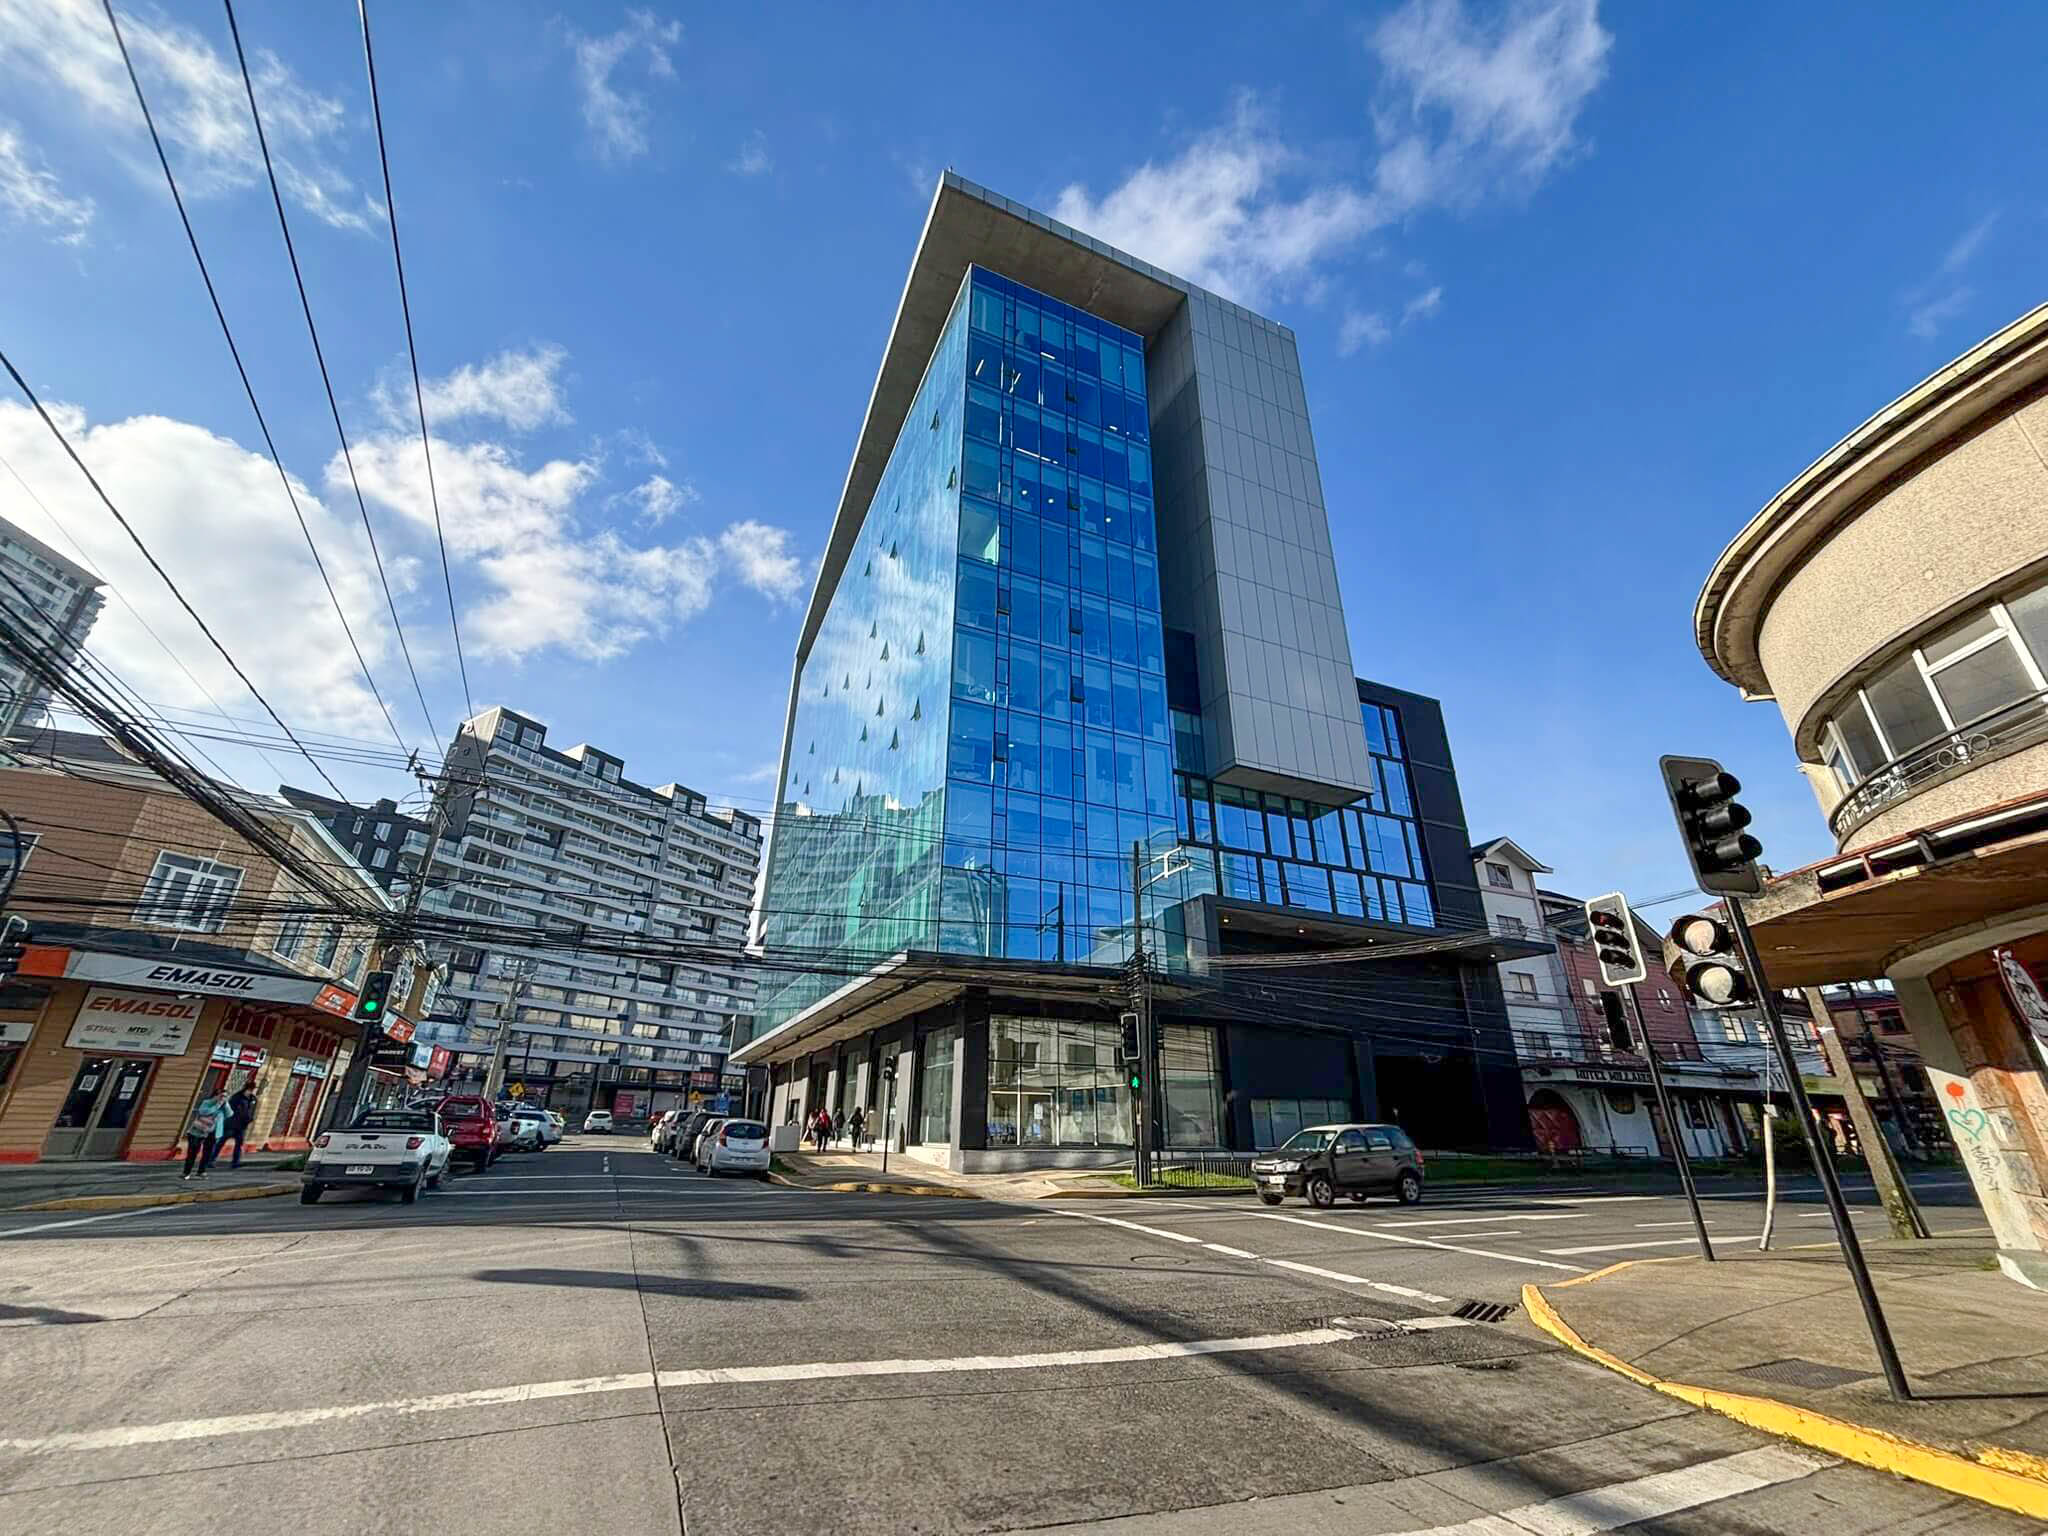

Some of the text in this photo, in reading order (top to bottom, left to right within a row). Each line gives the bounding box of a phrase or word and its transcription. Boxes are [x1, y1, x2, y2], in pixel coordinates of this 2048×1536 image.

[146, 966, 255, 990] EMASOL
[88, 996, 196, 1020] EMASOL
[84, 1024, 119, 1034] STIHL
